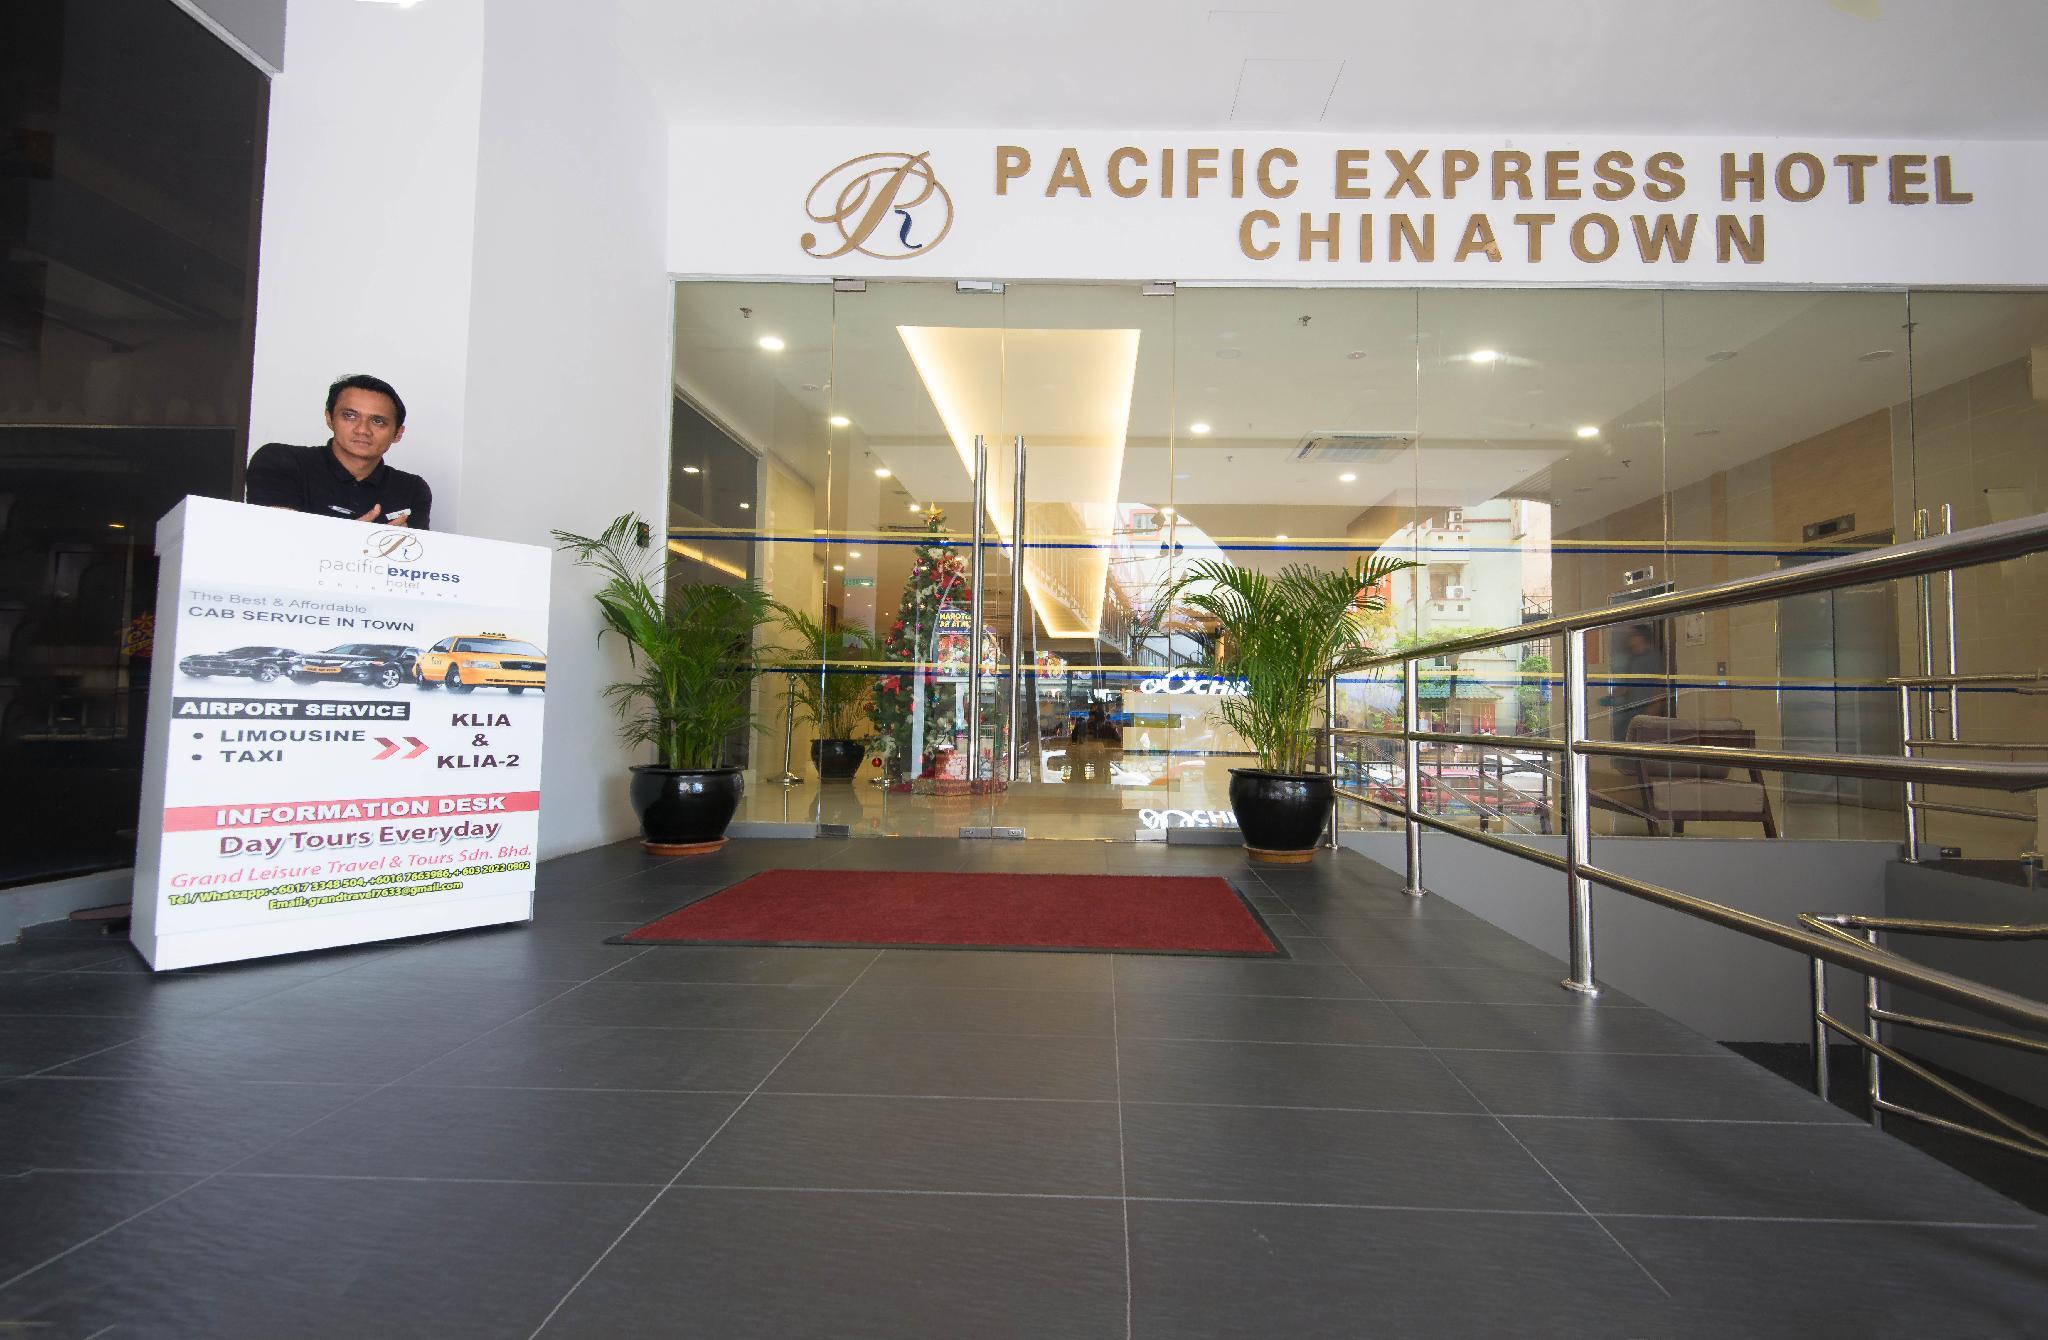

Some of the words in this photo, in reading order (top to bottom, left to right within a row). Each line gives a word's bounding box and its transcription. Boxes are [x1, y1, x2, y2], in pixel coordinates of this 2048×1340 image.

[996, 146, 1299, 198] PACIFIC
[1335, 149, 1686, 201] EXPRESS
[1720, 152, 1973, 206] HOTEL
[1239, 209, 1765, 264] CHINATOWN
[319, 558, 384, 575] pacific
[388, 566, 460, 583] express
[386, 579, 420, 589] hotel
[190, 591, 223, 602] The
[230, 594, 266, 606] Best
[272, 598, 284, 607] &
[289, 598, 367, 614] Affordable
[188, 606, 235, 619] CAB
[242, 610, 330, 626] SERVICE
[337, 617, 354, 628] IN
[361, 619, 414, 632] TOWN
[179, 702, 299, 715] AIRPORT
[305, 703, 406, 717] SERVICE
[451, 713, 511, 726] KLIA
[220, 730, 366, 742] LIMOUSINE
[472, 733, 489, 746] &
[220, 750, 283, 762] TAXI
[437, 754, 520, 768] KLIA-2
[216, 799, 430, 826] INFORMATION
[438, 796, 505, 813] DESK
[220, 836, 284, 857] Day
[290, 831, 372, 849] Tours
[379, 821, 500, 843] Everyday
[171, 868, 243, 888] Grand
[248, 863, 321, 881] Leisure
[328, 856, 385, 873] Travel
[389, 856, 403, 868] &
[409, 853, 453, 866] Tours
[460, 849, 493, 861] Sdn.
[498, 845, 532, 858] Bhd.
[270, 882, 310, 896] +6017
[311, 880, 340, 891] 3348
[341, 877, 366, 888] 504,
[367, 873, 403, 885] +6016
[405, 869, 452, 882] 7663986,
[482, 863, 506, 874] 2022
[269, 896, 307, 909] Email:
